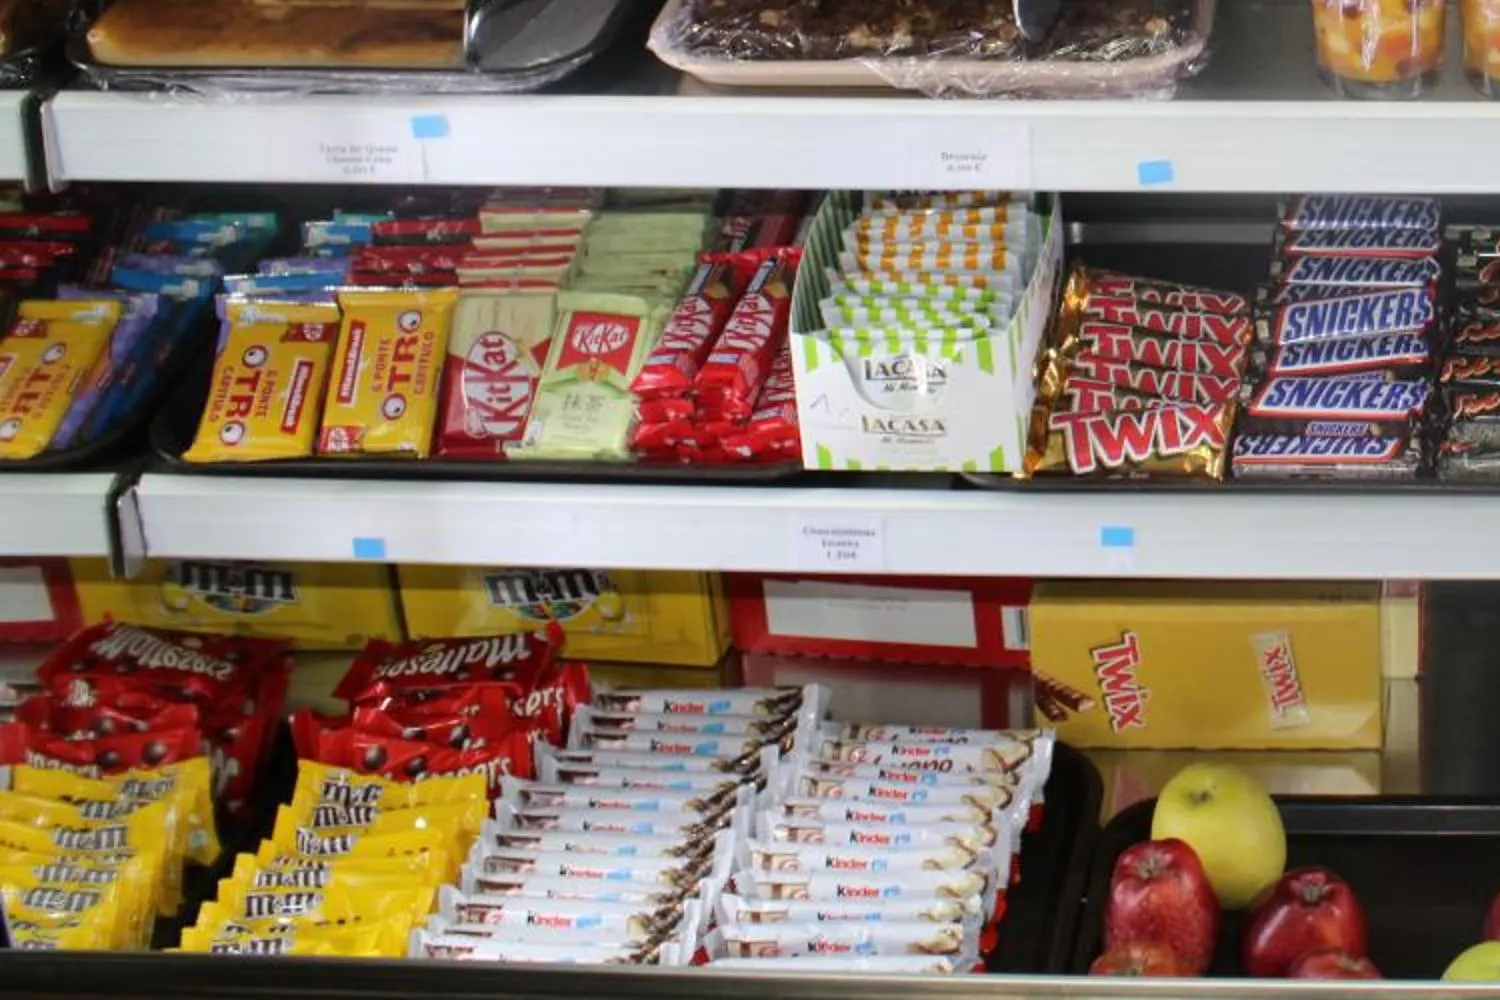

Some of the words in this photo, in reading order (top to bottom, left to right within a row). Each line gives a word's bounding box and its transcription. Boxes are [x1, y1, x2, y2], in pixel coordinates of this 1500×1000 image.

[1299, 196, 1438, 229] SNICKERS
[578, 322, 625, 353] KitKat
[1285, 291, 1431, 344] SNICKERS
[464, 334, 531, 423] KitKat
[1263, 379, 1429, 410] SNICKERS
[862, 415, 946, 434] LACASA
[1050, 403, 1227, 475] TWIX
[1090, 631, 1148, 734] TWIX
[1263, 646, 1305, 713] TWIX
